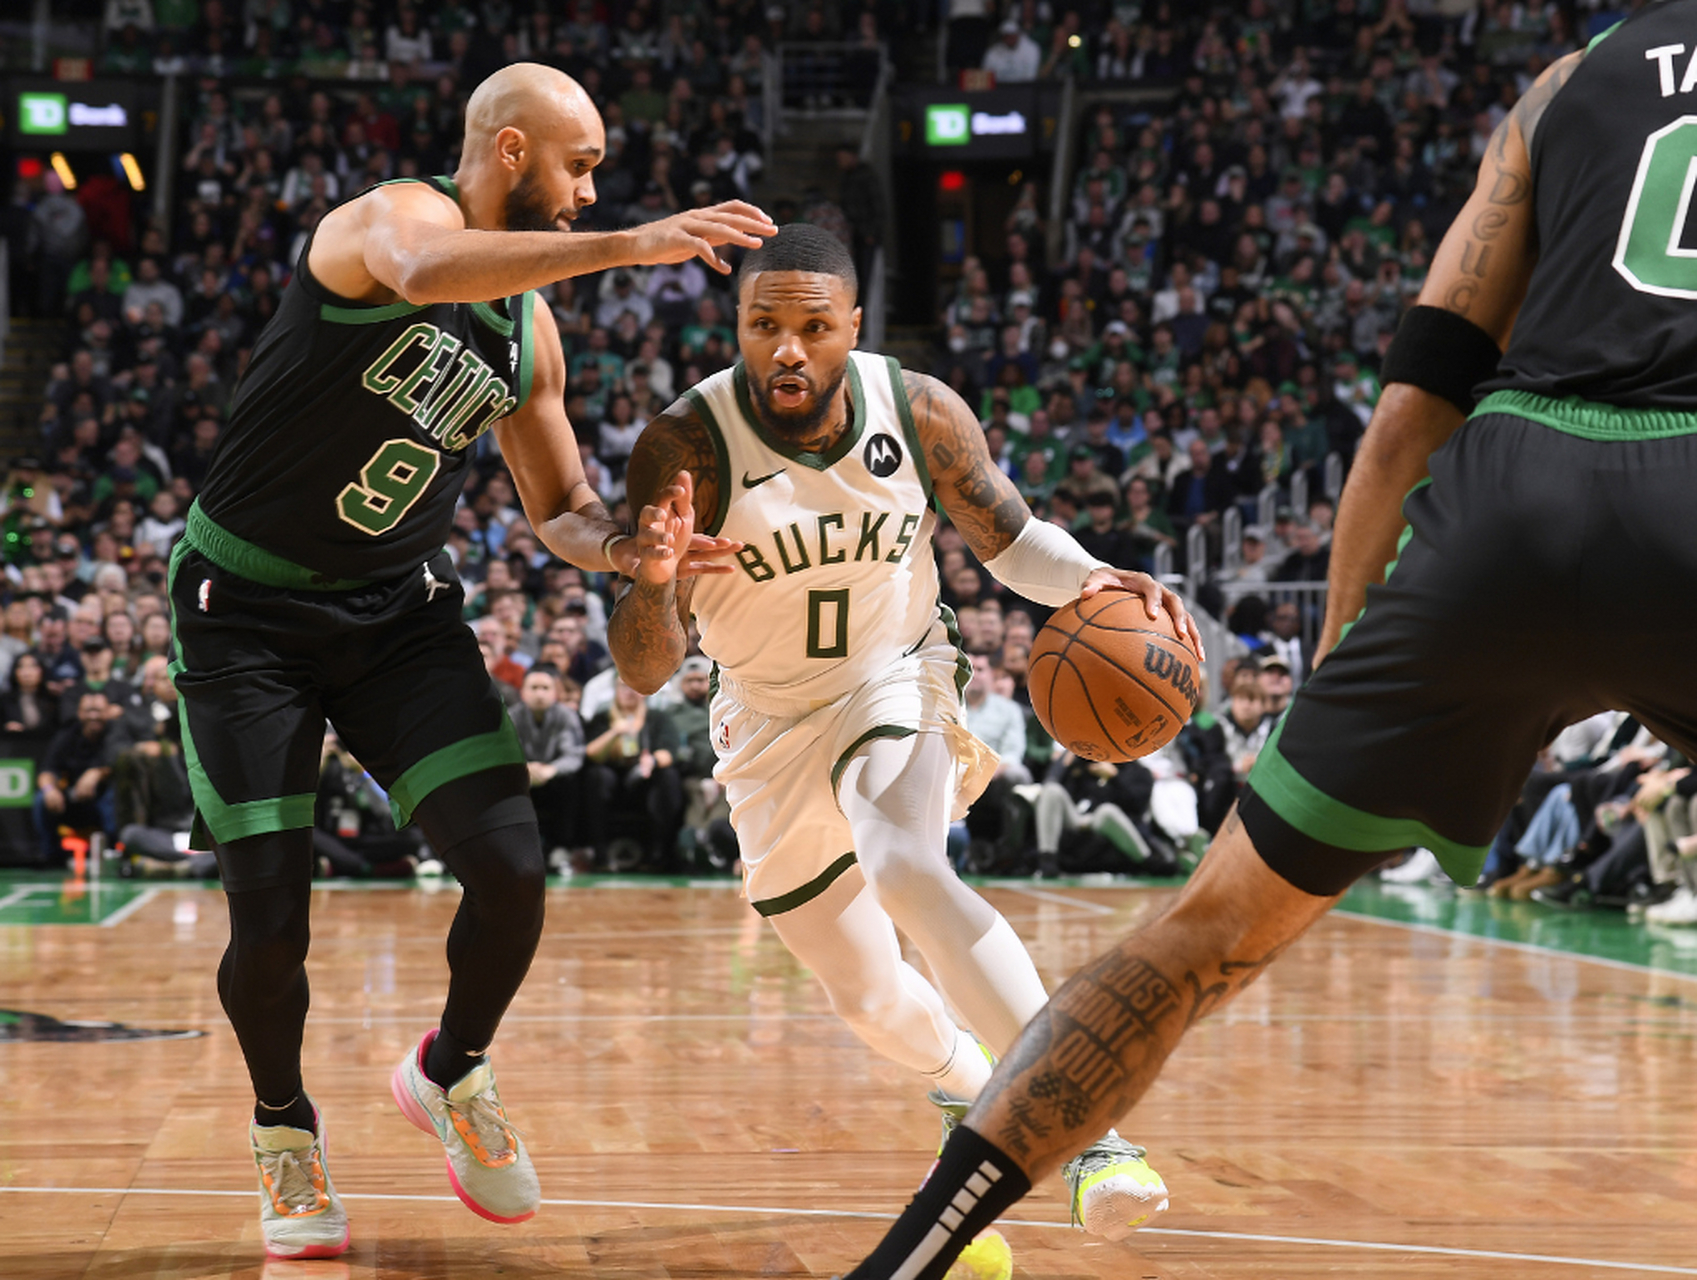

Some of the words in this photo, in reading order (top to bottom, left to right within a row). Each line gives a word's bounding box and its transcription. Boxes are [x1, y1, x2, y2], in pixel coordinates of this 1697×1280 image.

[23, 98, 66, 127] TD
[929, 110, 968, 138] TD
[1445, 165, 1533, 315] Deuc
[335, 438, 441, 537] 9
[734, 511, 920, 583] BUCKS
[805, 587, 850, 659] 0
[1144, 641, 1198, 708] Wilso
[0, 766, 31, 799] D
[1102, 957, 1181, 1022] JUST
[1051, 1028, 1125, 1100] QUIT
